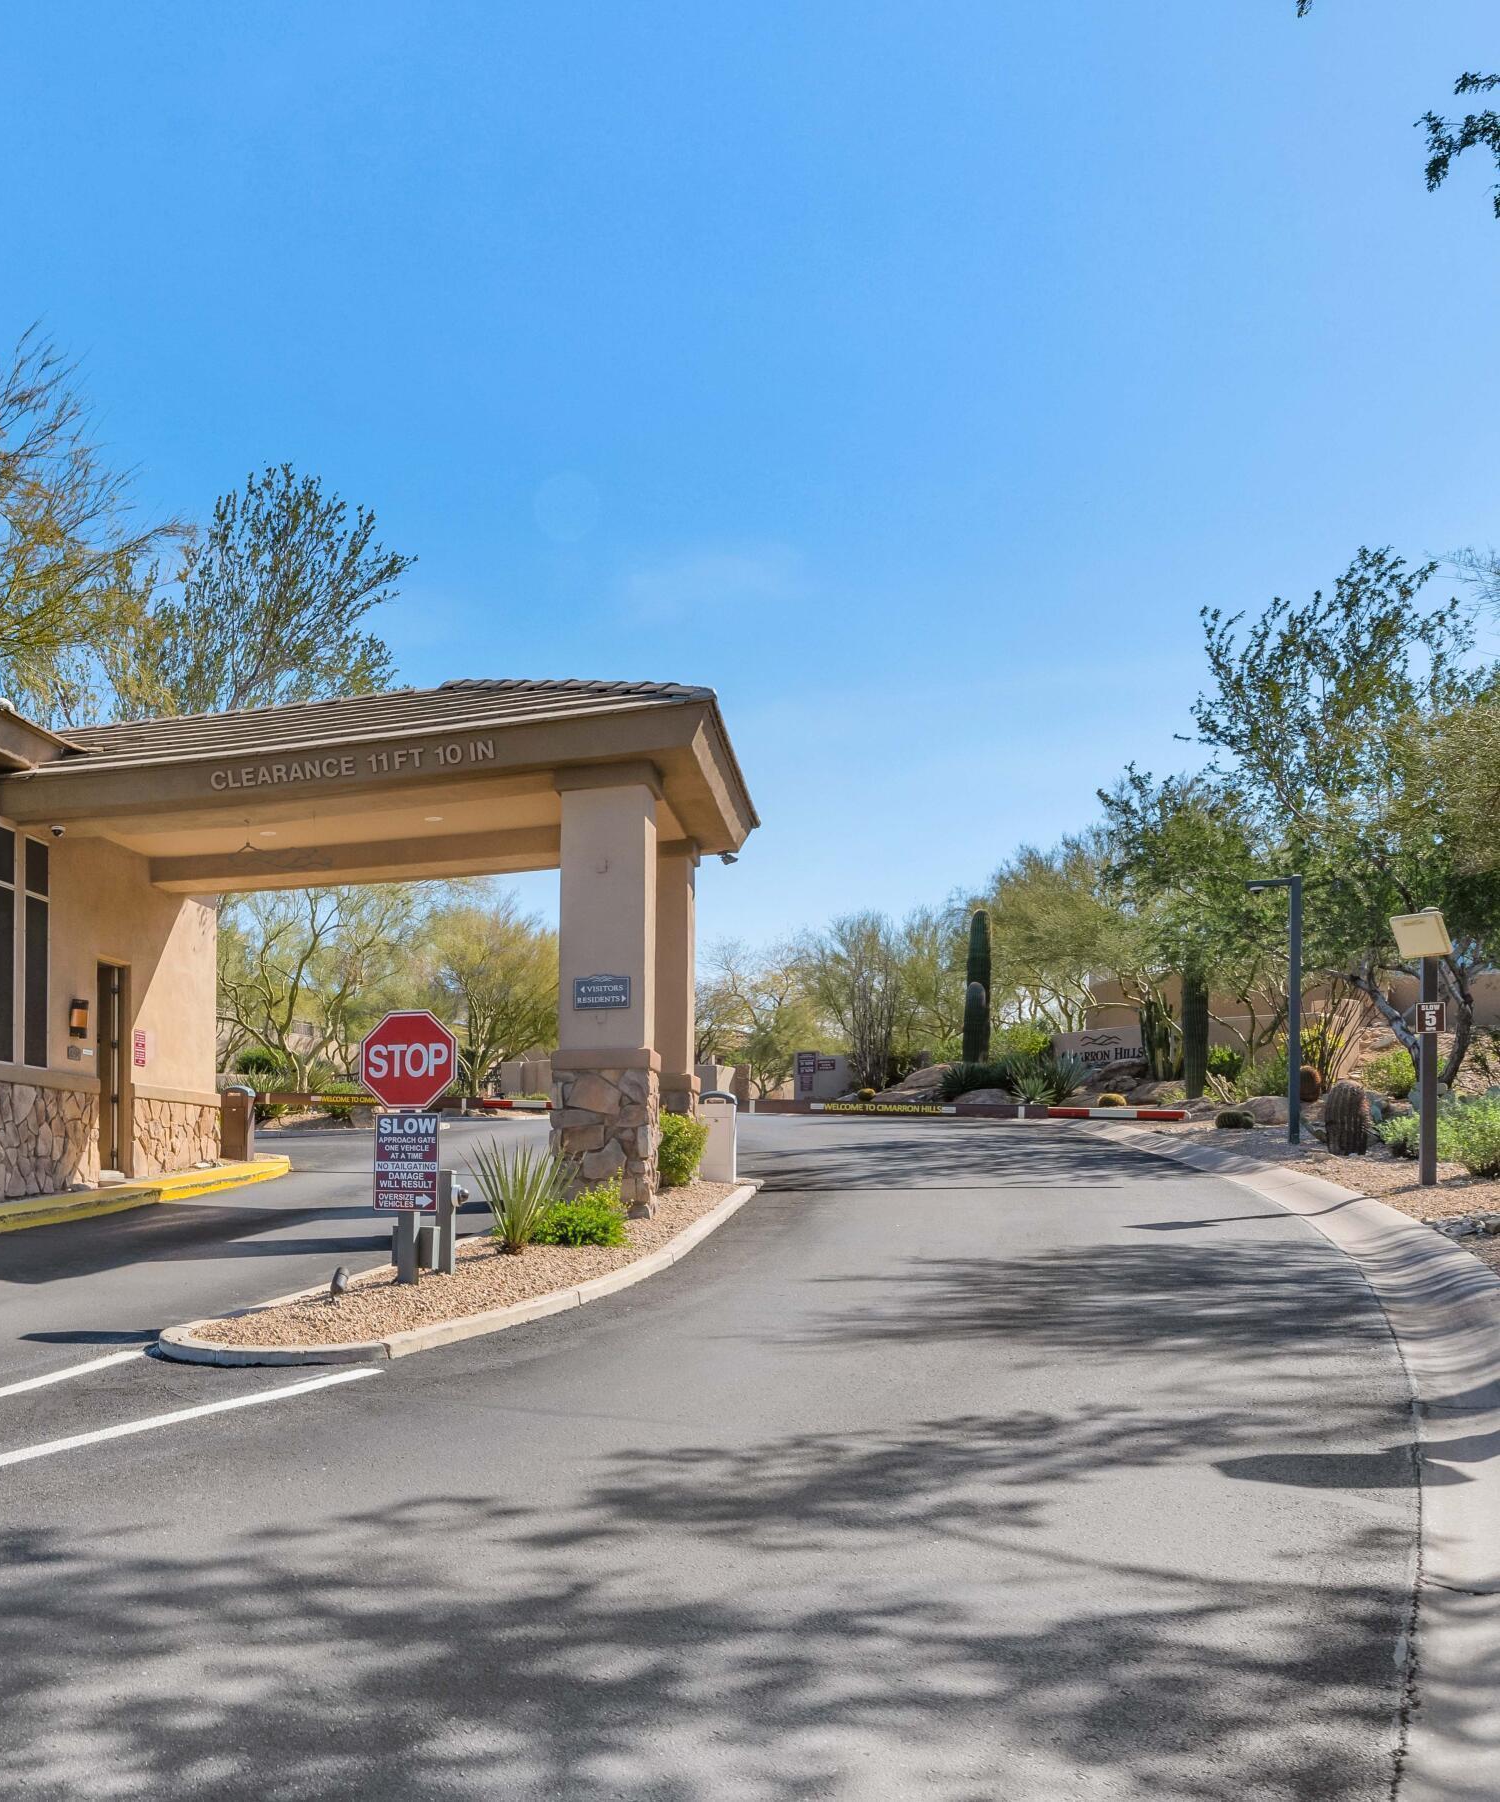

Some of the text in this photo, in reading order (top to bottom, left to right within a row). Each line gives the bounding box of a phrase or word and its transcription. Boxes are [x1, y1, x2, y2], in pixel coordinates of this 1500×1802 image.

[210, 757, 356, 790] CLEARANCE
[394, 748, 424, 770] FT
[434, 743, 463, 765] 10
[469, 740, 495, 761] IN
[577, 995, 620, 1004] RESIDENTS
[1425, 1010, 1436, 1026] 5
[368, 1042, 449, 1079] STOP
[320, 1095, 350, 1103] WELCOME
[824, 1103, 943, 1113] WELCOME TO CIMARRON HILLS
[379, 1117, 436, 1134] SLOW
[400, 1144, 430, 1152] VEHICLE
[377, 1162, 436, 1171] NO TAILGATING
[388, 1172, 425, 1180] DAMAGE
[380, 1180, 433, 1189] WILL RESULT
[378, 1193, 414, 1201] OVERSIZE
[378, 1200, 414, 1208] VEHICLES
